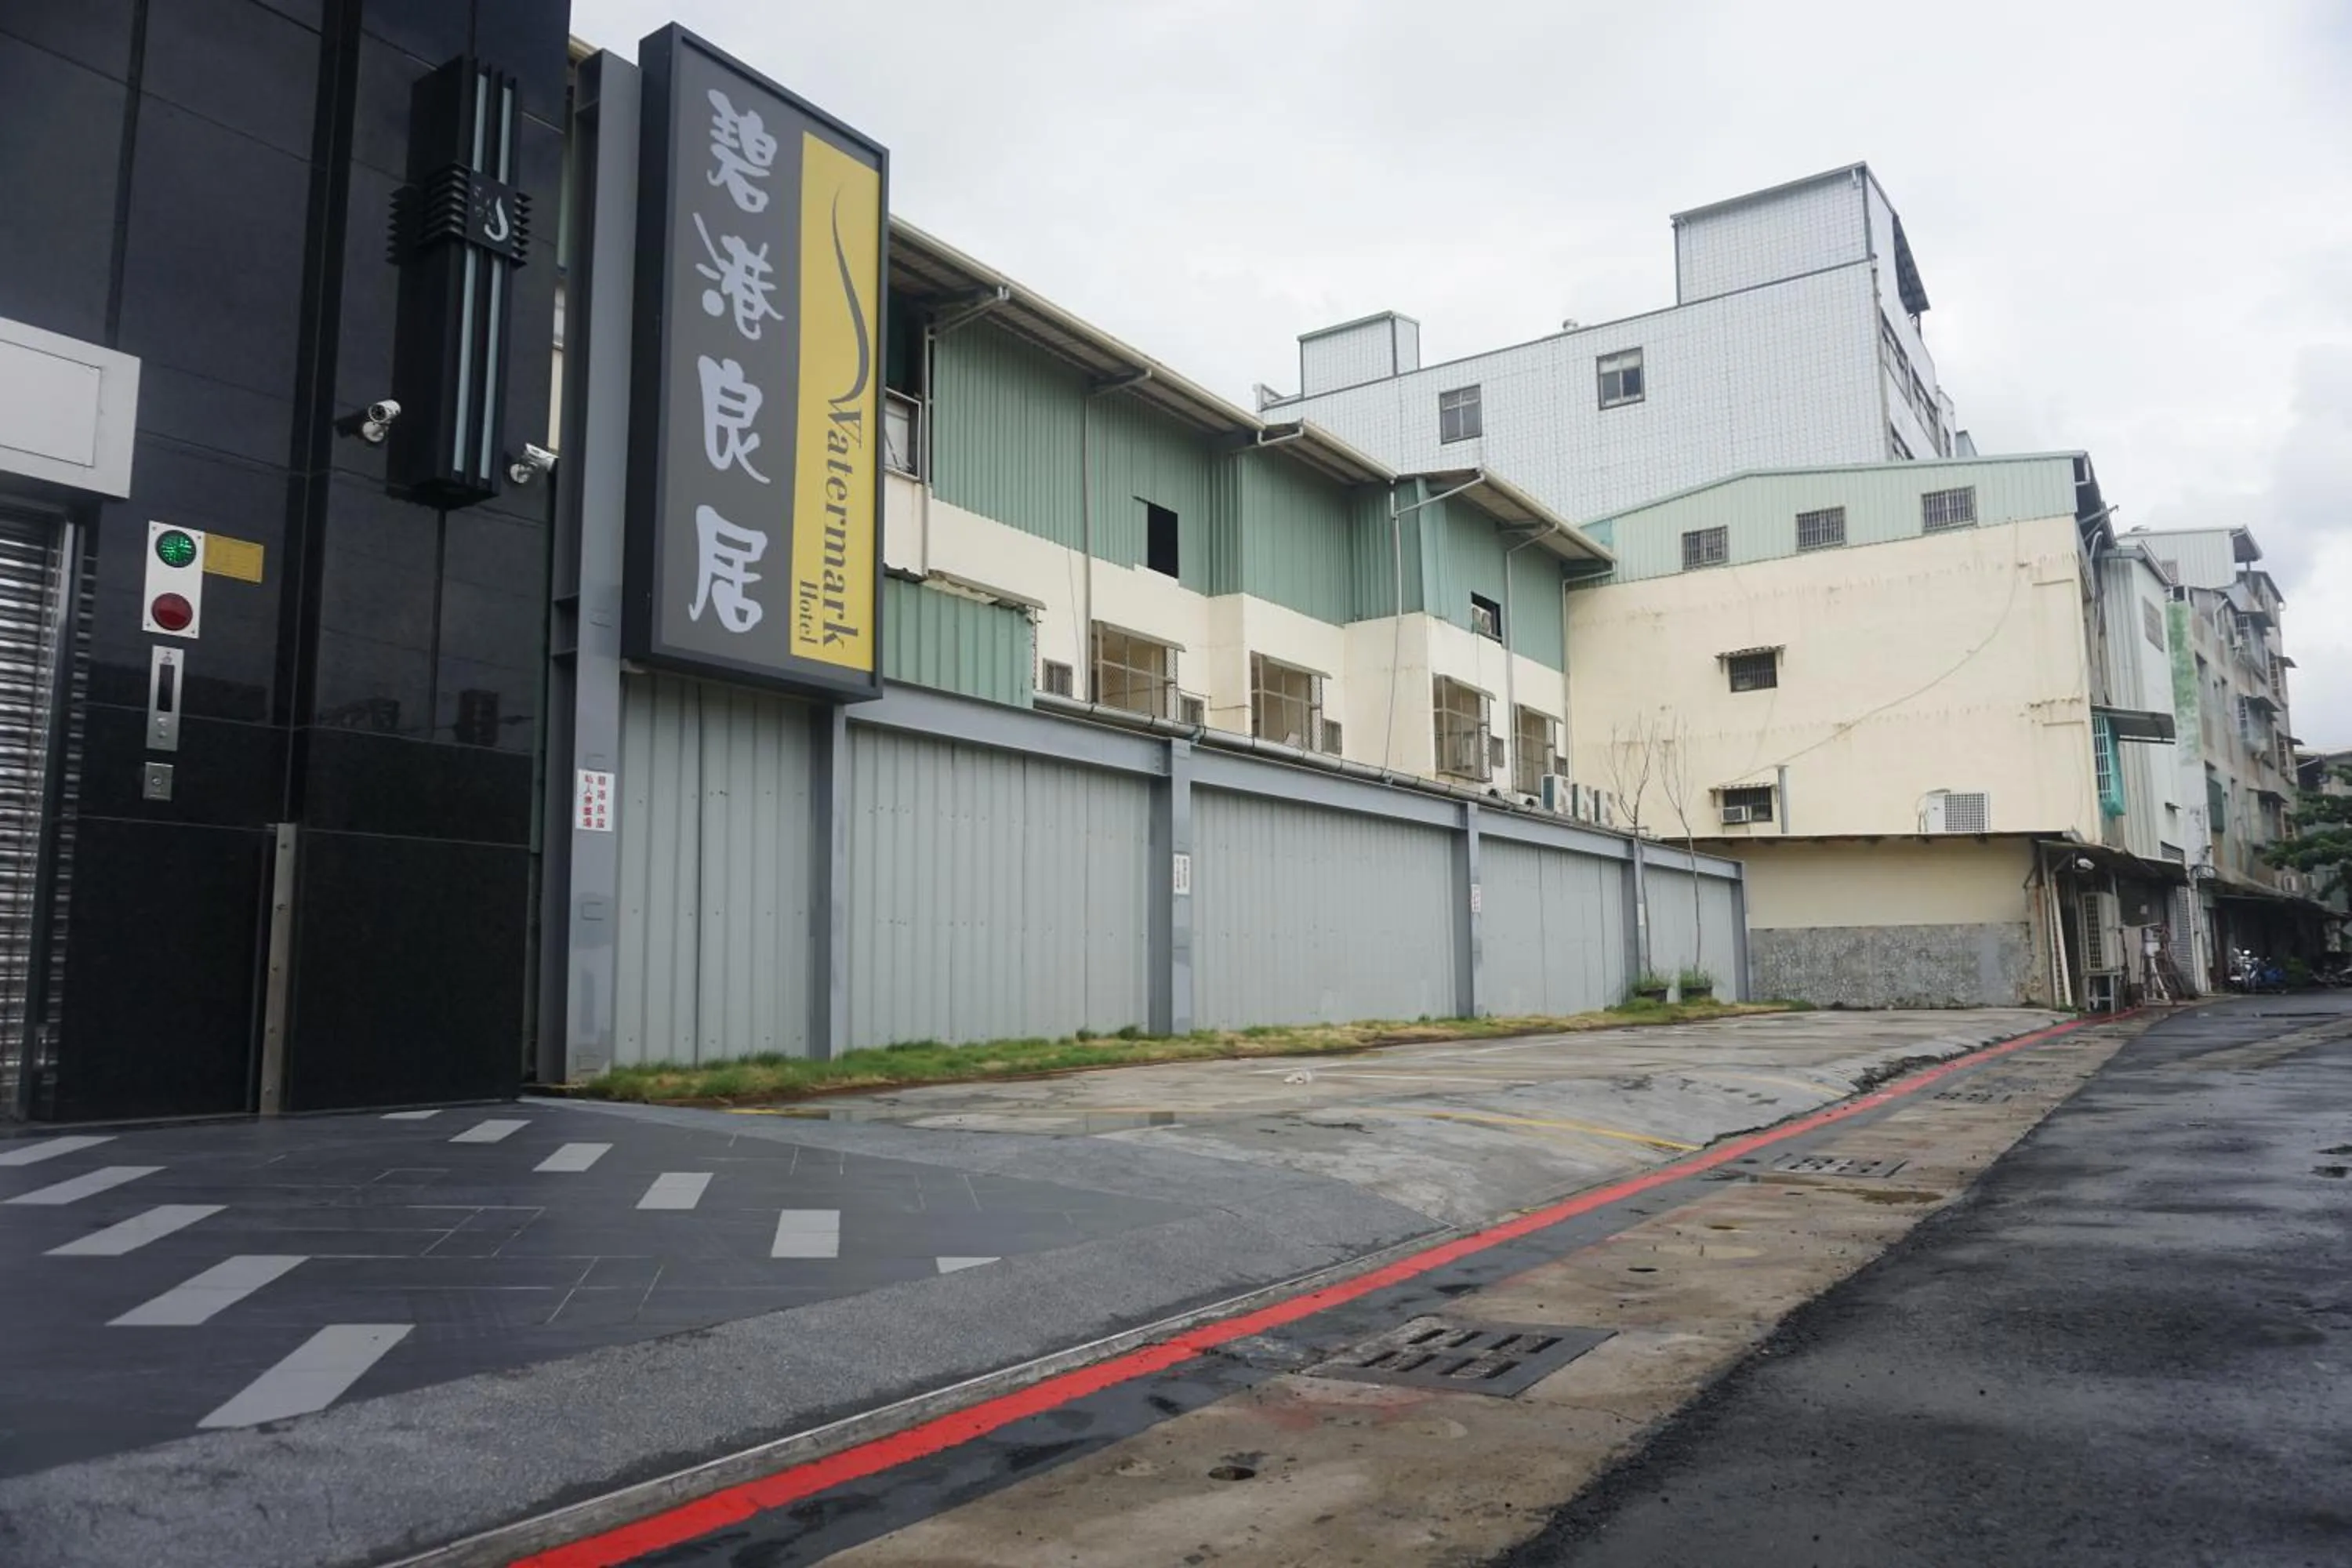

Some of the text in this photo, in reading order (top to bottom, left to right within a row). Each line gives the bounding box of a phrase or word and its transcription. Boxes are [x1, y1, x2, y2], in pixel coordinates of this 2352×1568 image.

[689, 88, 783, 633] 碧港良居
[799, 579, 818, 644] Hotel
[822, 392, 863, 648] Watermark
